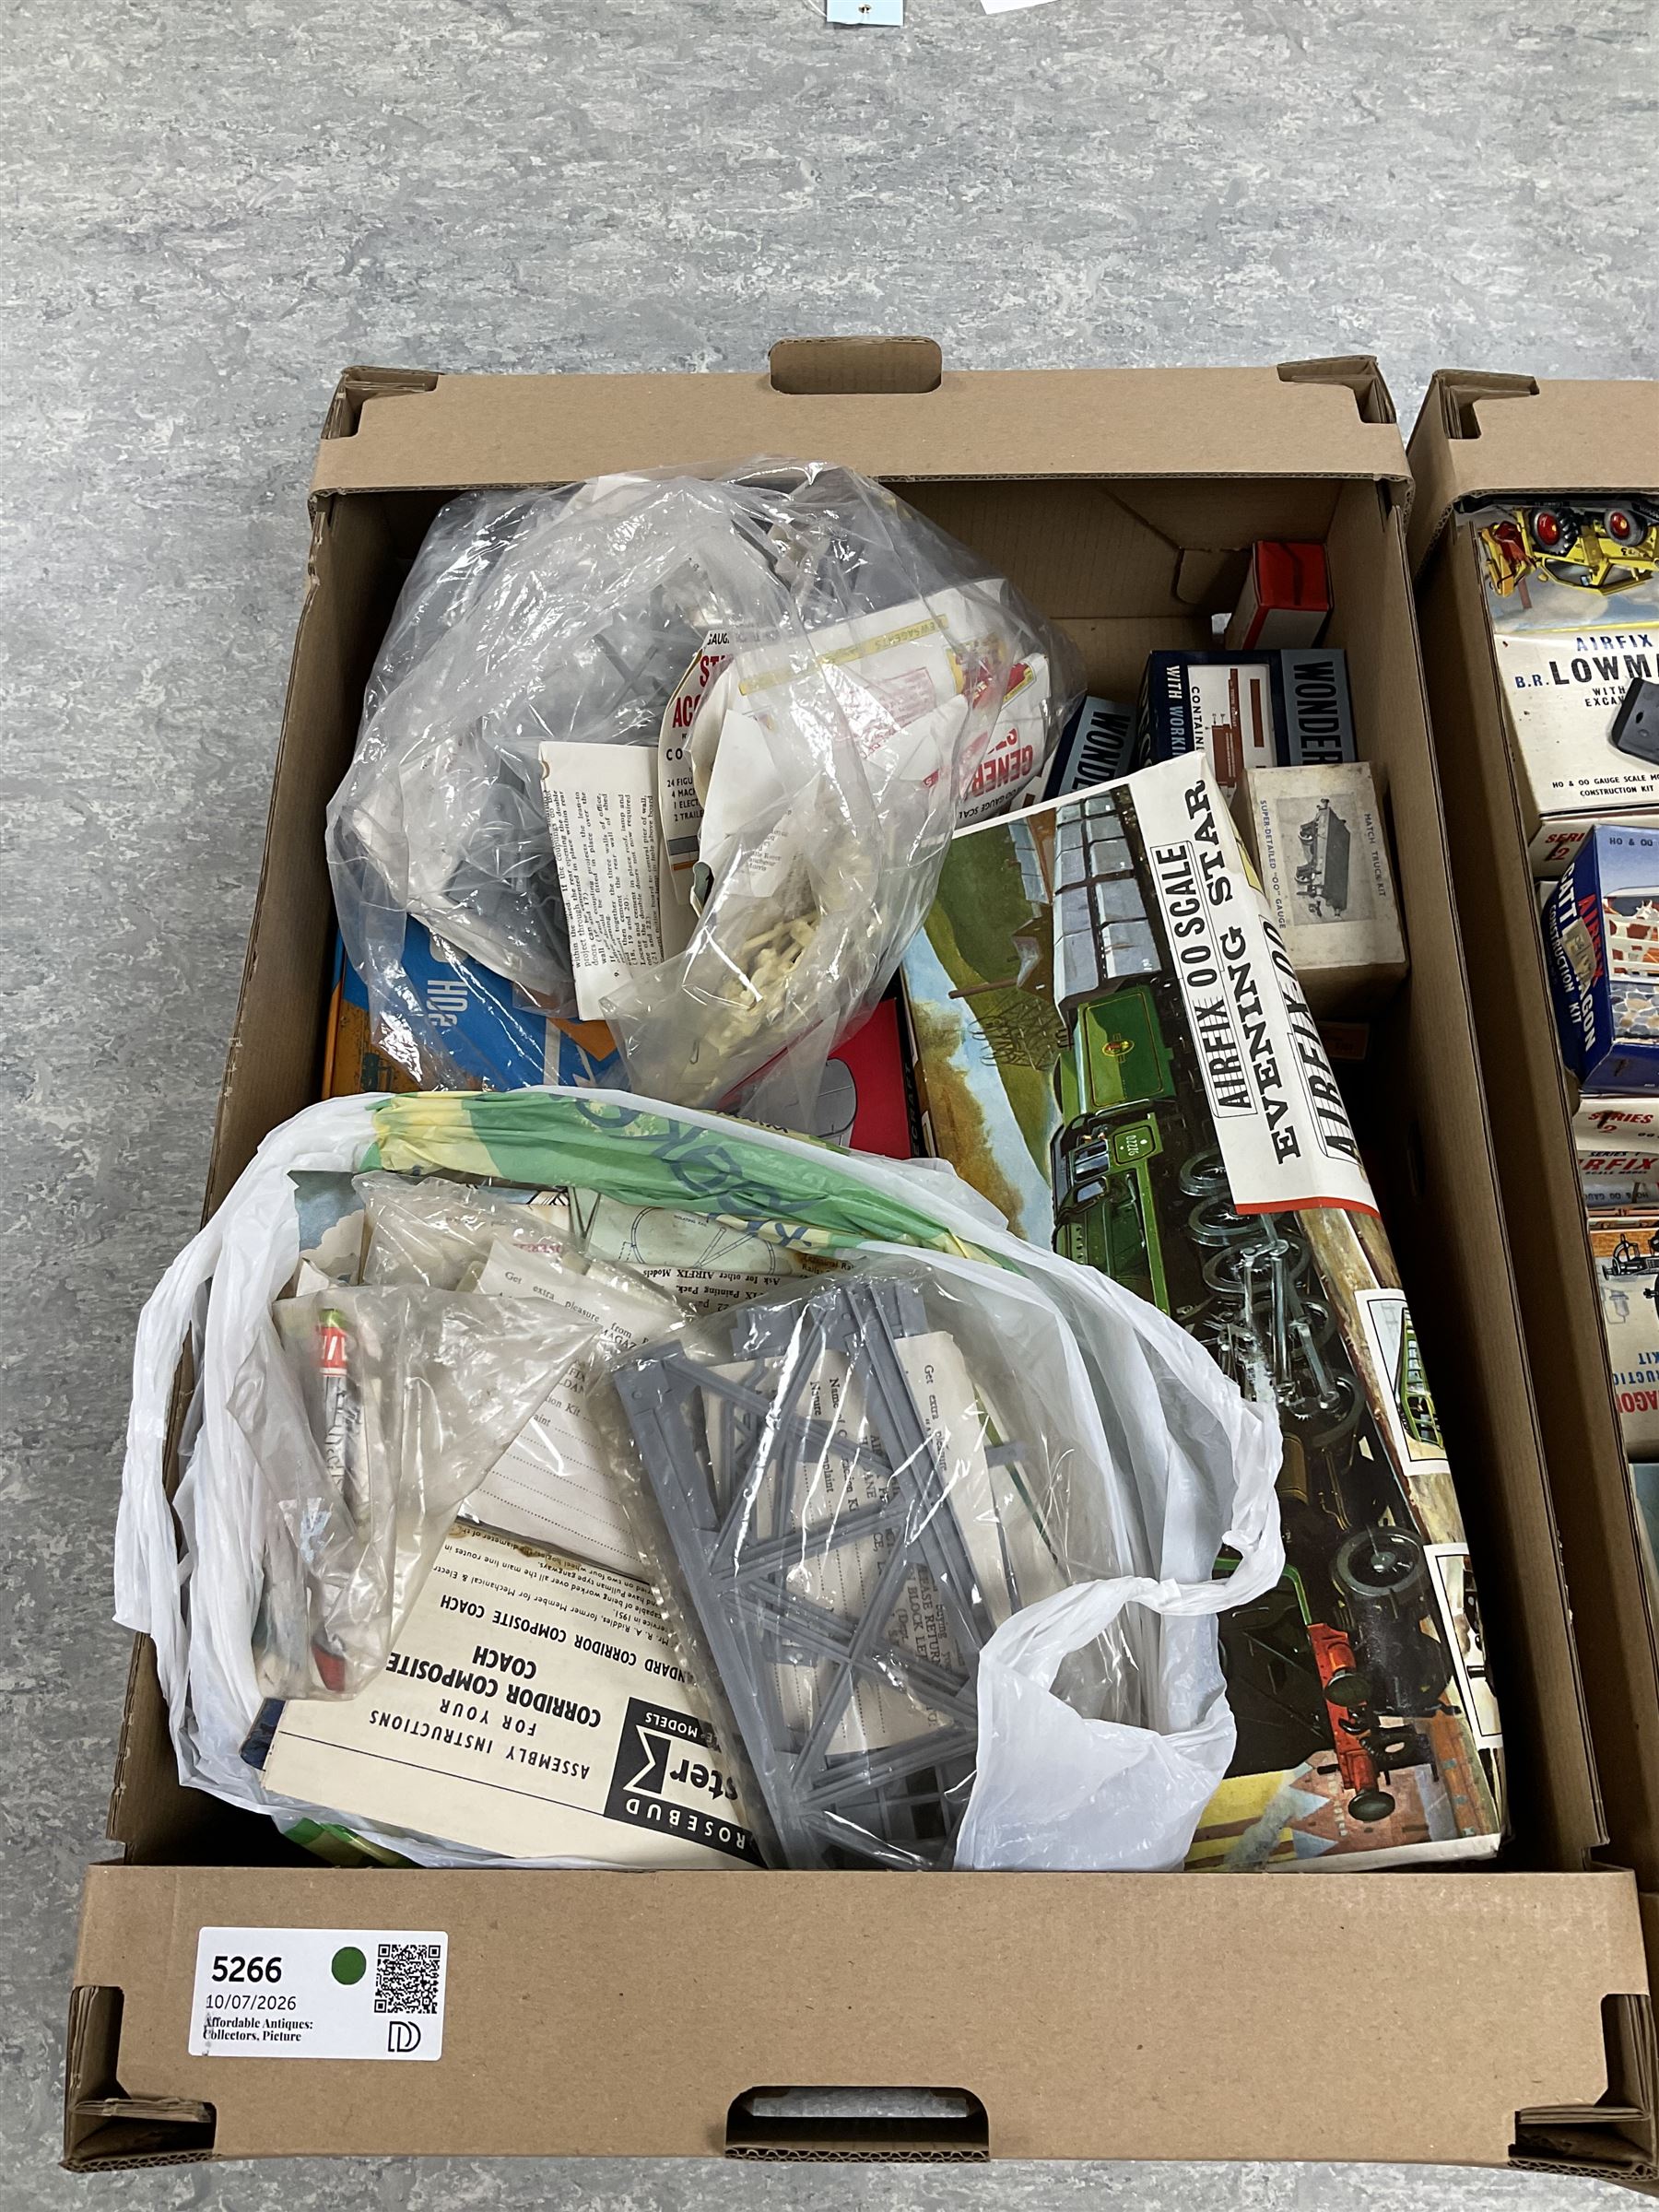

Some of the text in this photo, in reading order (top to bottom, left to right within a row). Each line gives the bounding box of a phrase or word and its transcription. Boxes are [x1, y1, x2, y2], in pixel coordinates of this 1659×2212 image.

[1577, 634, 1653, 651] AIRFIX
[1165, 665, 1182, 699] WITH
[1515, 675, 1548, 688] B.R.
[1594, 687, 1626, 696] WITH
[666, 779, 675, 787] 24
[1594, 776, 1619, 784] GAUGE
[1623, 773, 1646, 782] SCALE
[671, 790, 676, 798] 4
[1580, 786, 1638, 796] CONSTRUCTION
[979, 794, 1006, 811] GAUGE
[550, 822, 563, 861] couplings
[1363, 813, 1385, 897] MATCH TRUCK KIT
[1259, 799, 1277, 869] SUPER-DETAILED
[1274, 898, 1286, 929] GAUGE
[1156, 845, 1204, 938] SCALE
[571, 942, 581, 968] within
[598, 947, 606, 963] wall
[1188, 780, 1300, 1163] EVENING STAR
[1548, 904, 1582, 1024] CONSTRUCTION KIT
[1196, 999, 1250, 1109] AIRFIX
[643, 1268, 780, 1285] Ask for other AIRFIX Models
[676, 1285, 699, 1294] Pack.
[703, 1287, 739, 1297] Painting
[503, 1269, 632, 1338] Get extra pleasure from
[828, 1377, 843, 1408] Name
[564, 1402, 582, 1417] Kit
[923, 1363, 949, 1472] Get extra pleasure
[470, 1529, 481, 1539] of
[480, 1532, 519, 1551] diameter
[460, 1573, 468, 1582] &
[535, 1560, 577, 1581] gangways.
[576, 1572, 595, 1586] type
[587, 1568, 606, 1581] four
[442, 1543, 663, 1620] capable of being worked over all the main line routes in
[468, 1575, 516, 1597] Mechanical
[606, 1574, 622, 1585] two
[623, 1580, 634, 1589] on
[516, 1590, 532, 1602] for
[594, 1581, 627, 1598] Pullman
[626, 1591, 645, 1604] have
[441, 1594, 485, 1618] COACH
[532, 1594, 568, 1612] Member
[904, 1585, 924, 1630] BLOCK
[569, 1606, 598, 1621] former
[610, 1607, 632, 1621] 1951.
[632, 1615, 641, 1624] in
[492, 1611, 567, 1643] COMPOSITE
[598, 1615, 631, 1633] Riddles,
[631, 1627, 642, 1637] A.
[642, 1630, 653, 1641] R.
[654, 1635, 669, 1646] Mr.
[573, 1635, 637, 1665] CORRIDOR
[471, 1645, 536, 1678] COACH
[387, 1653, 601, 1726] CORRIDOR COMPOSITE
[439, 1700, 536, 1735] FOR YOUR
[646, 1712, 698, 1737] MODELS
[370, 1710, 591, 1779] ASSEMBLY INSTRUCTIONS
[625, 1798, 746, 1848] ROSEBUD
[211, 1955, 282, 1983] 5266
[206, 1994, 296, 2010] 10/07/2026
[204, 2017, 313, 2030] Affordable Antiques:
[262, 2030, 301, 2041] Picture
